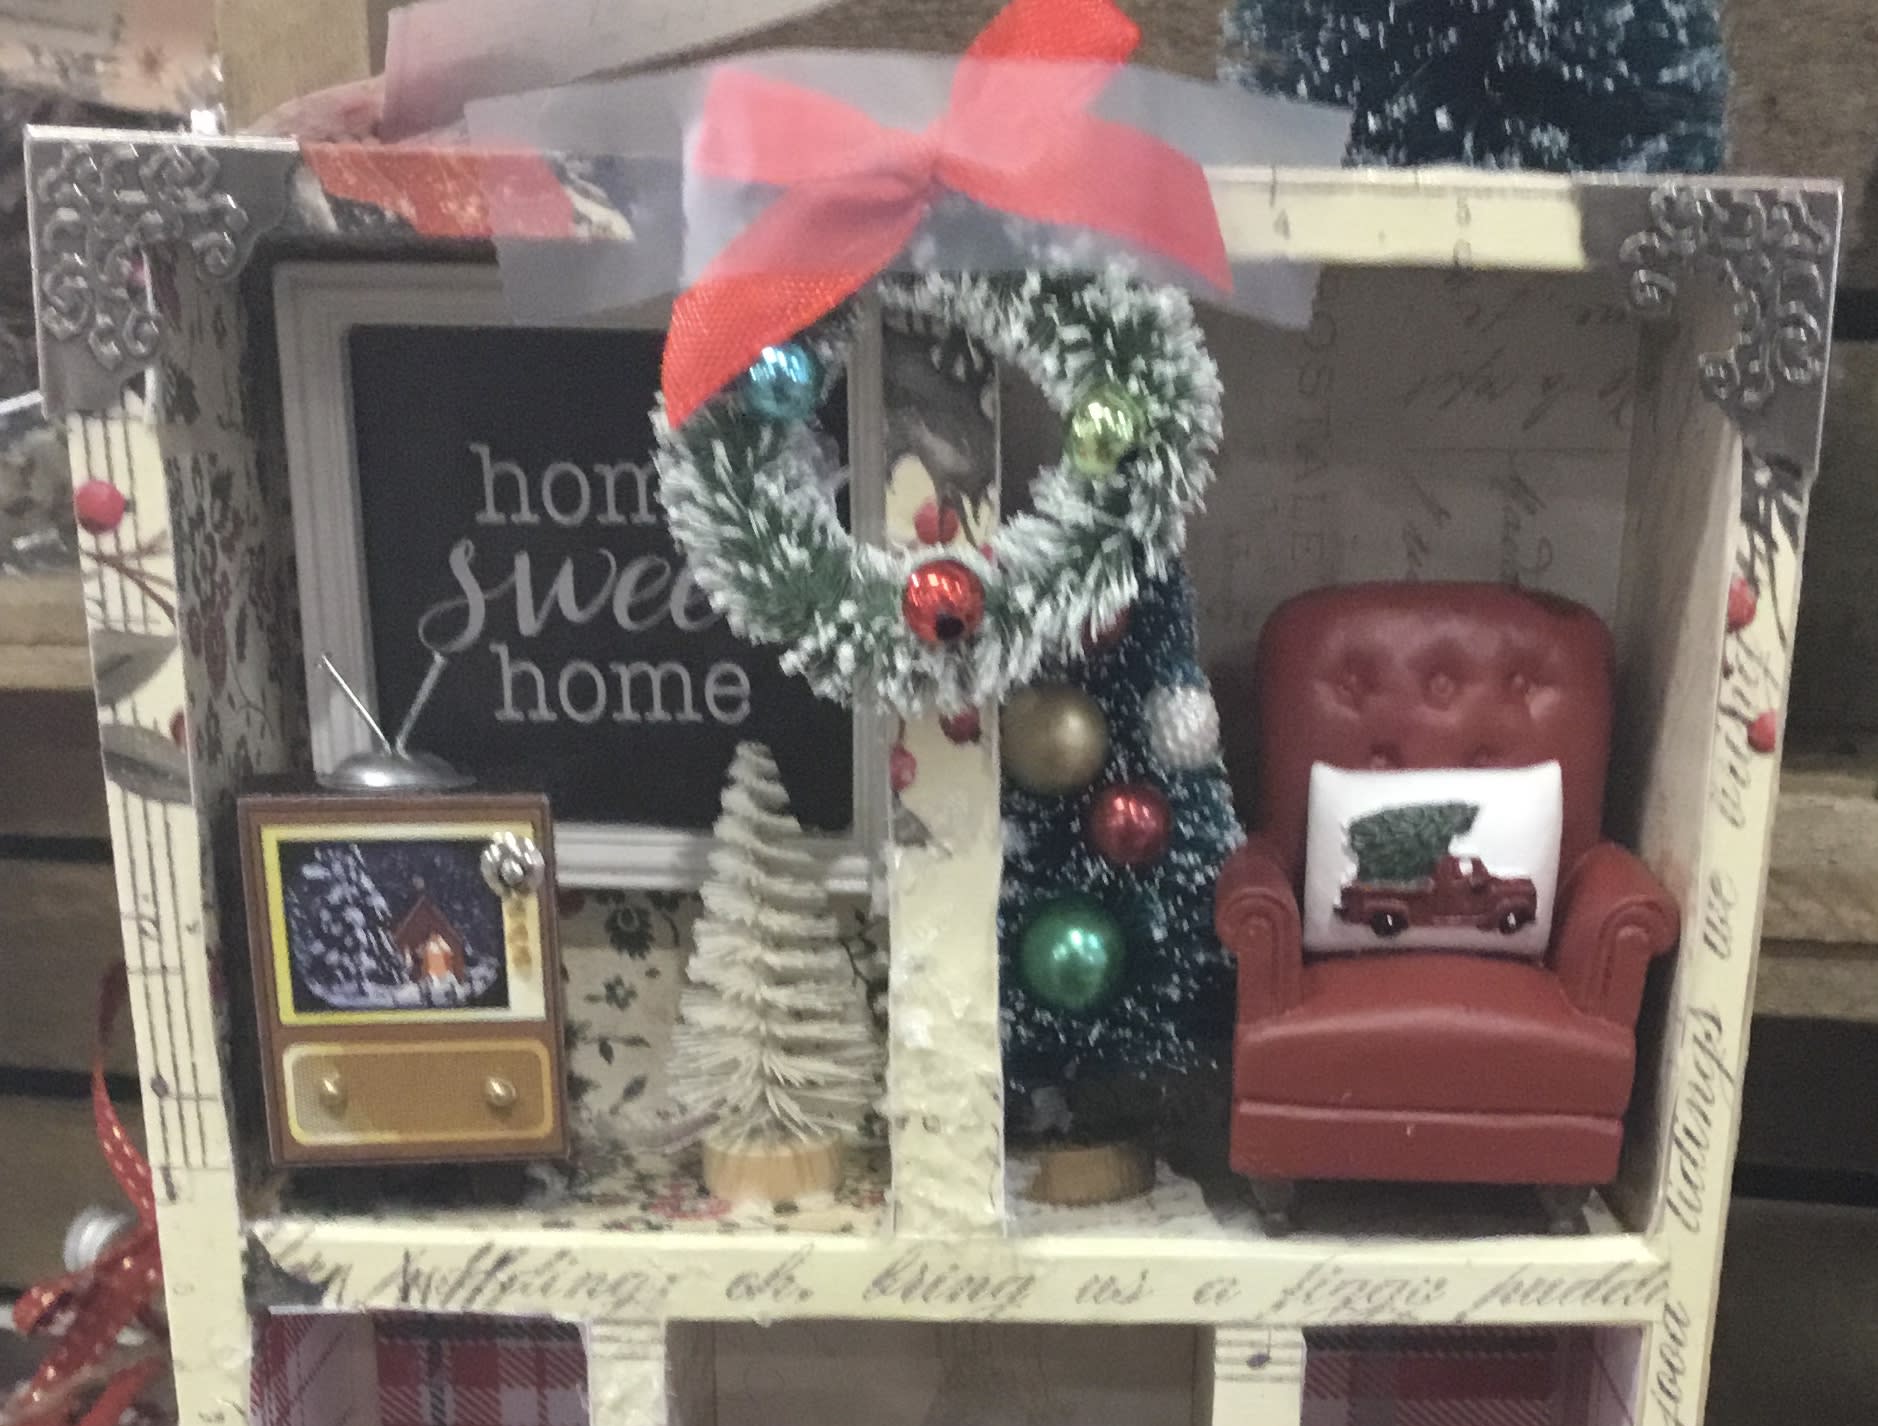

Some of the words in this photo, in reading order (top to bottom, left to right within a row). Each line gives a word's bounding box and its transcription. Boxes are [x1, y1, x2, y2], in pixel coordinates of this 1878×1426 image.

[470, 443, 658, 526] hom
[418, 538, 722, 654] swee
[490, 643, 753, 724] home
[1702, 871, 1737, 960] we
[1075, 1267, 1154, 1305] us
[1192, 1275, 1241, 1306] a
